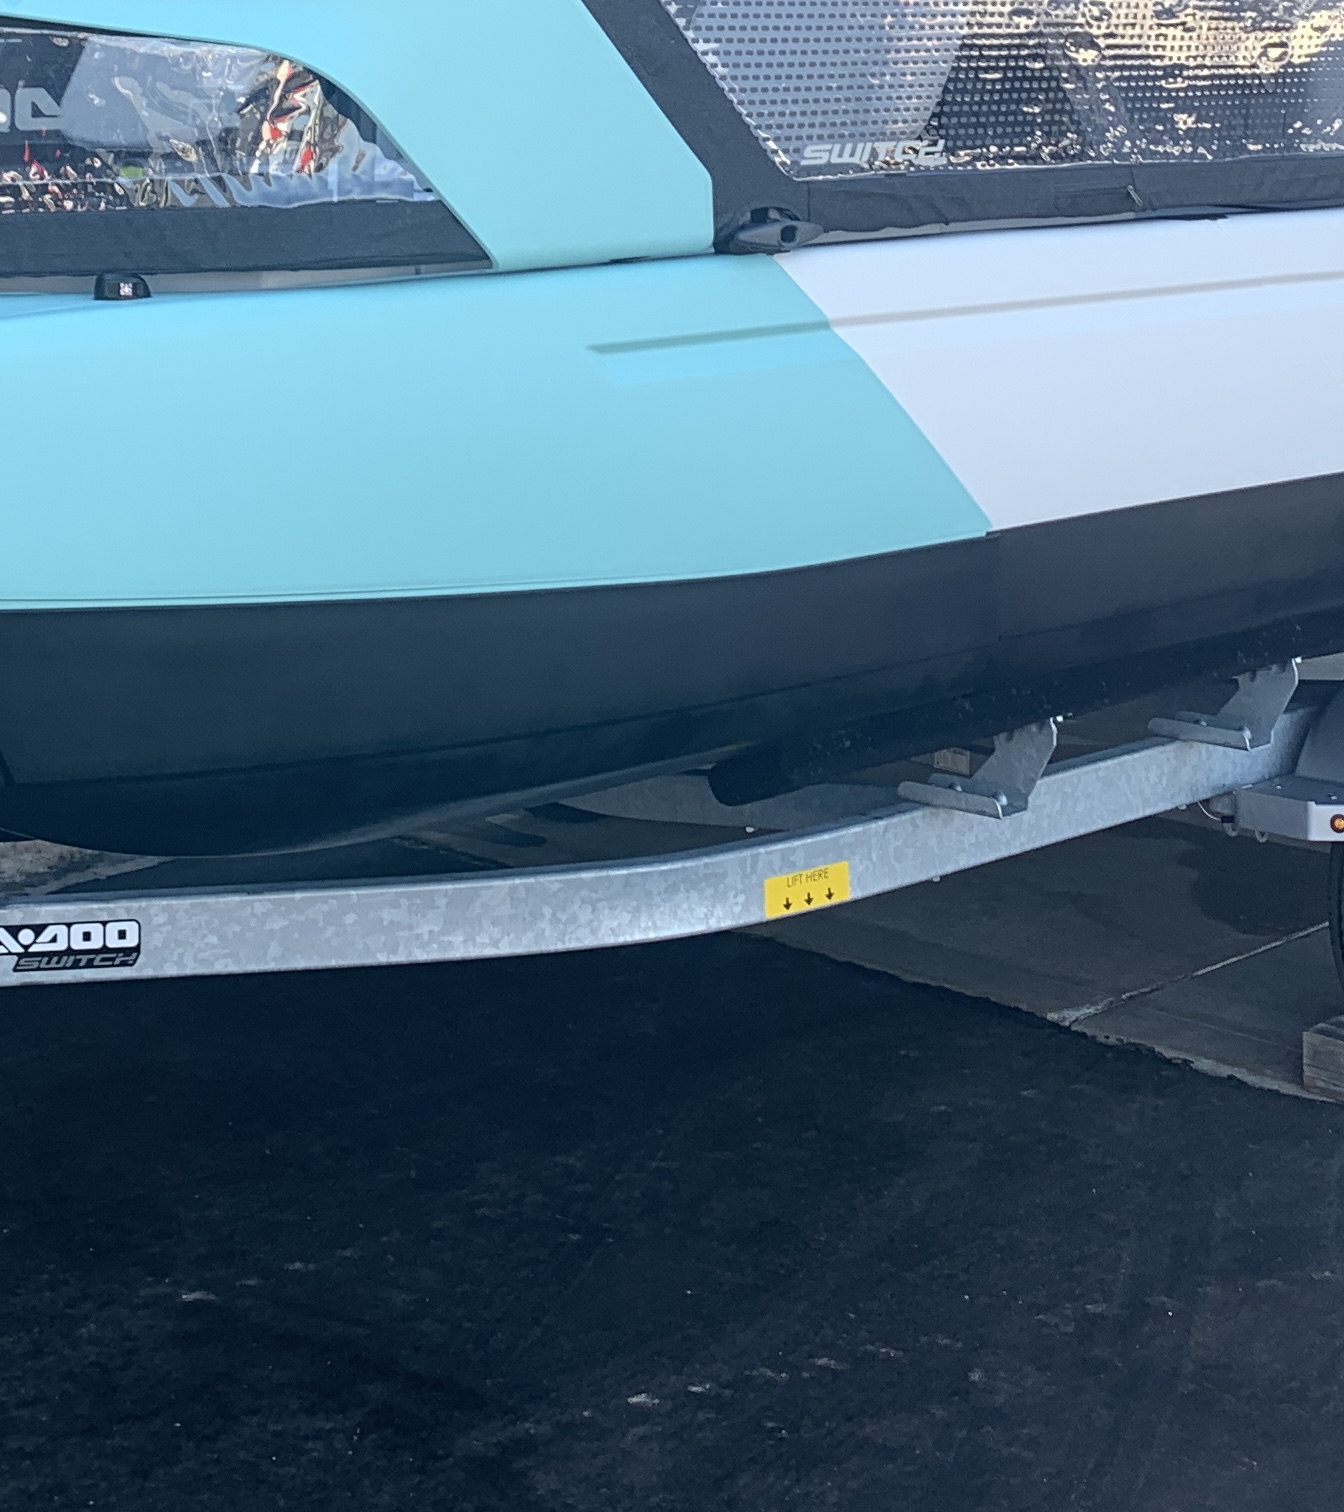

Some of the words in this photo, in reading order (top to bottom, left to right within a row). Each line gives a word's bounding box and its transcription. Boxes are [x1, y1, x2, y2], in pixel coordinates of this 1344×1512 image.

[800, 139, 947, 167] SWITCH
[786, 873, 803, 888] LIFT
[805, 868, 830, 883] HERE
[15, 952, 138, 971] SWITCH
